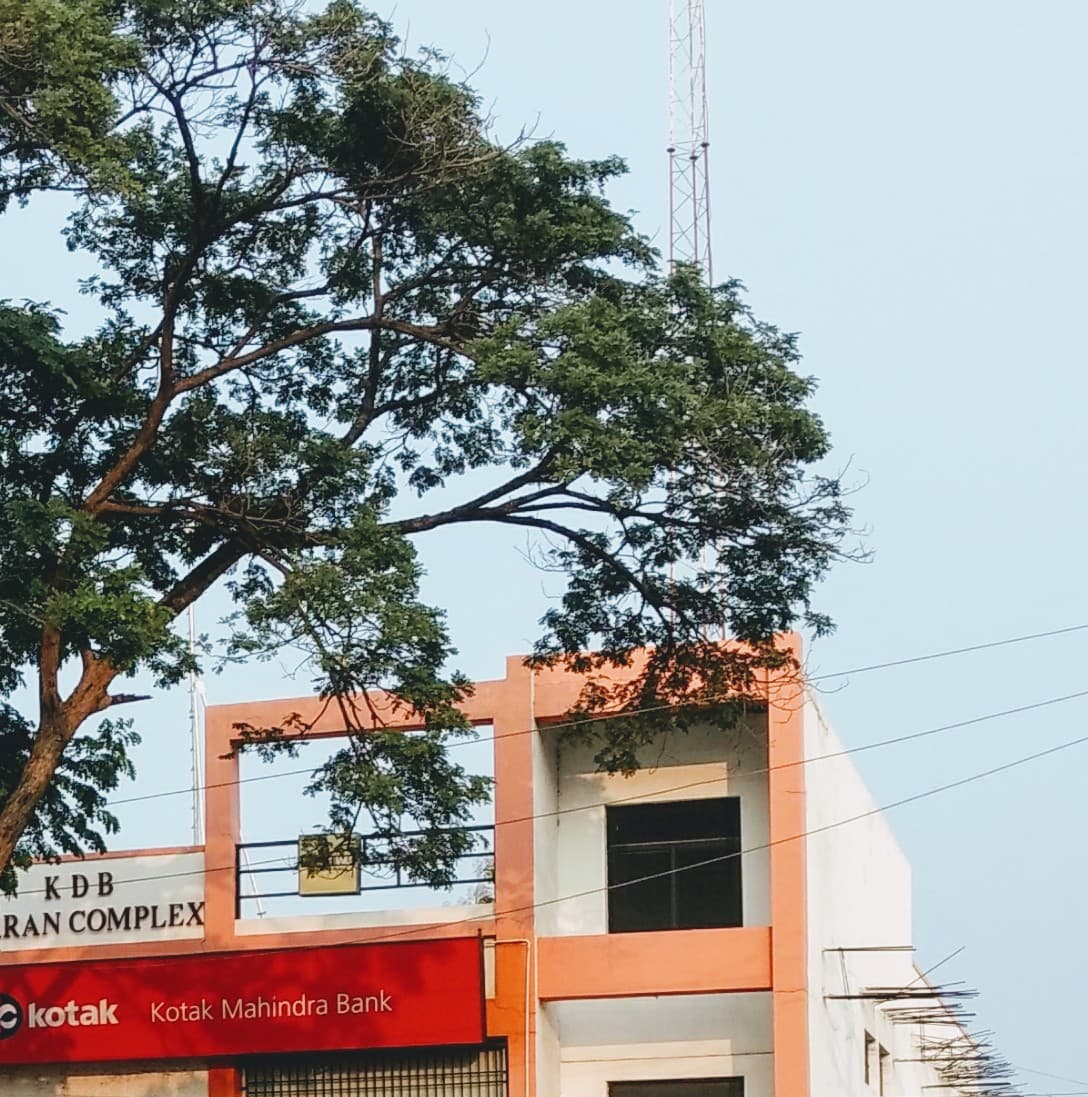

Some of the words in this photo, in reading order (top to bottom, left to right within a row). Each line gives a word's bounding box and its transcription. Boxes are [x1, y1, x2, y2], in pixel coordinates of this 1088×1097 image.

[68, 901, 206, 933] COMPLEX
[28, 998, 119, 1029] kotak
[151, 999, 212, 1023] Kotak
[222, 994, 327, 1020] Mahindra
[337, 989, 393, 1014] Bank
